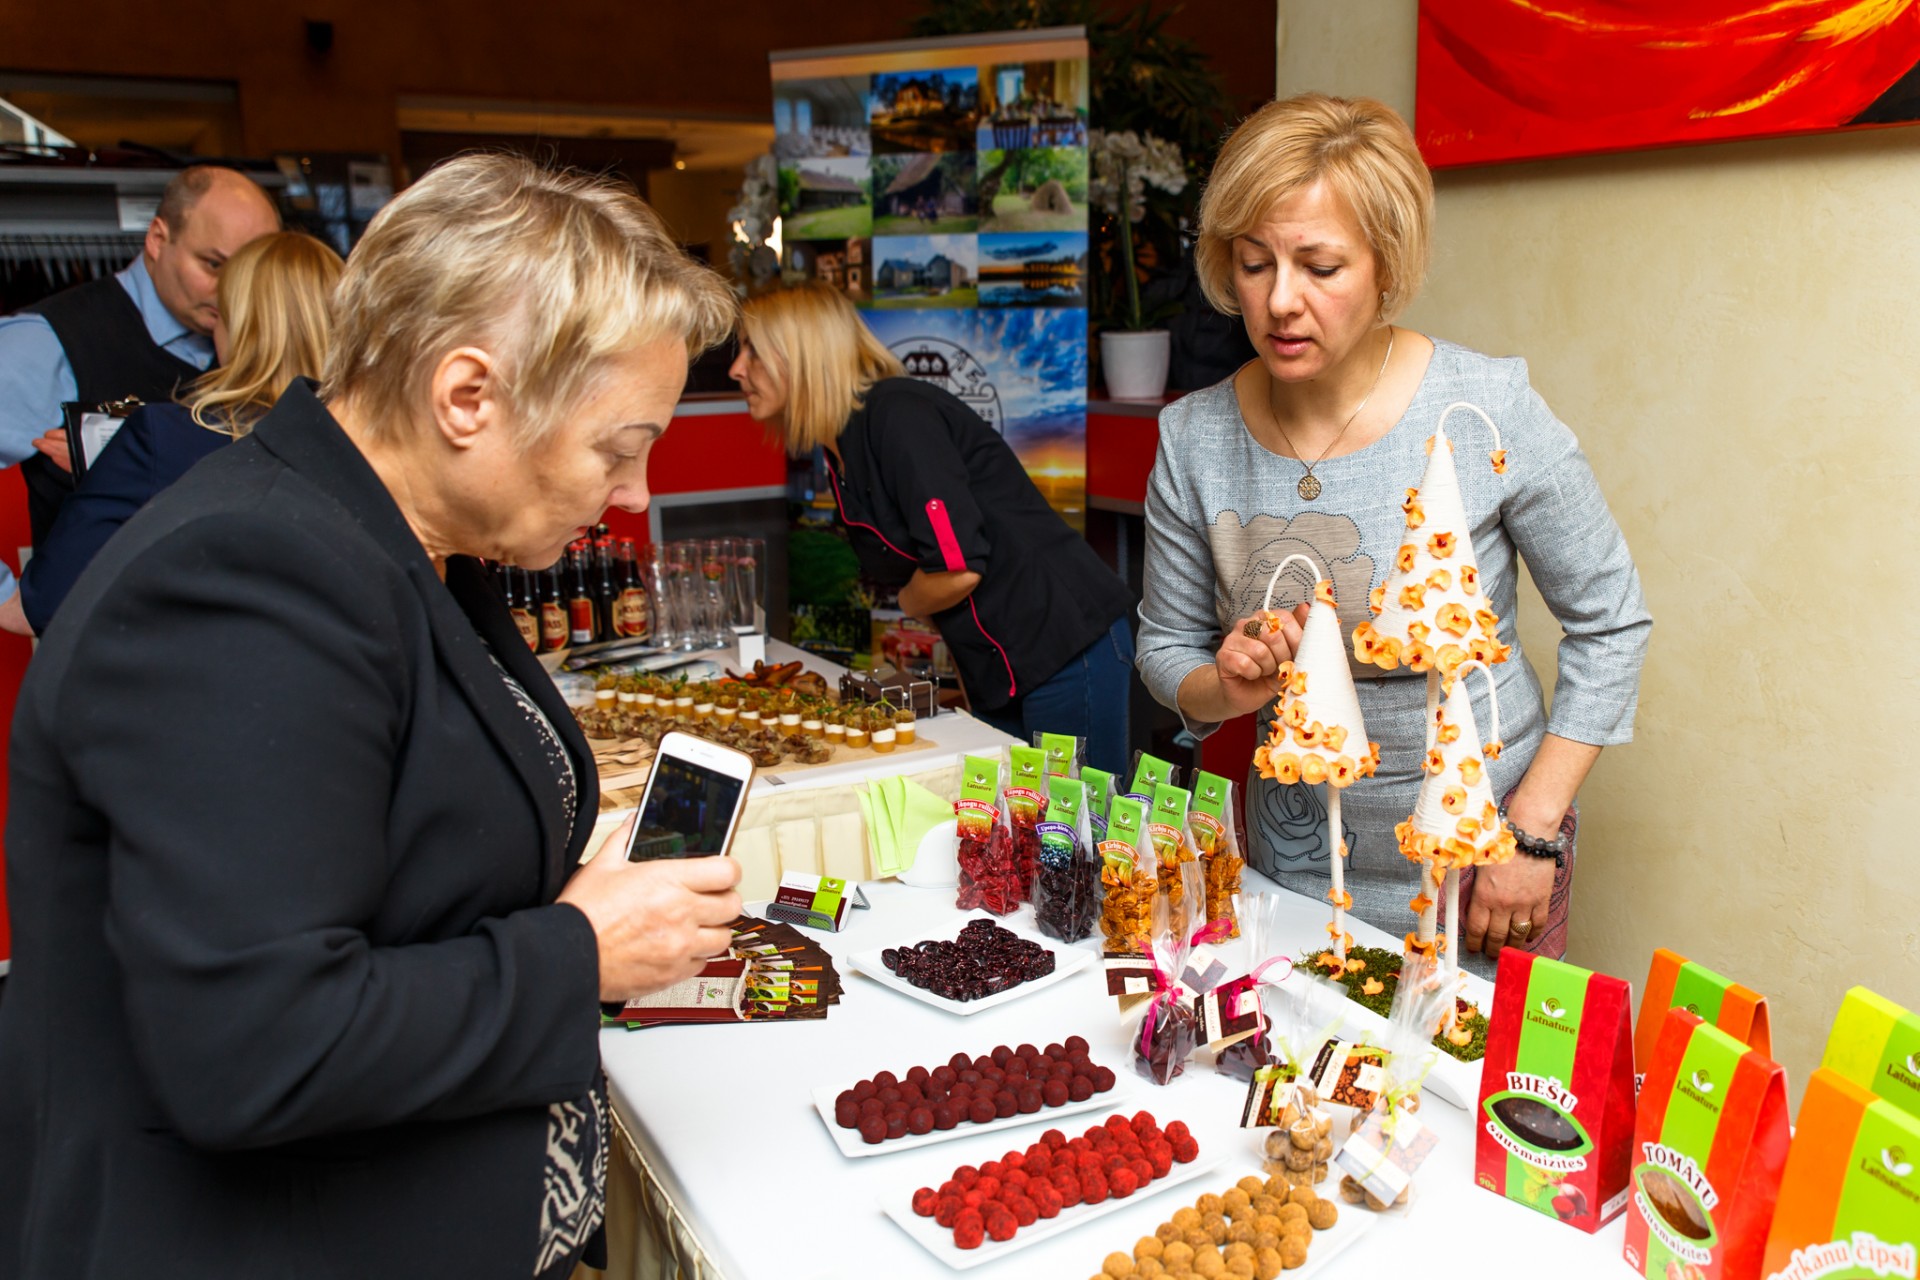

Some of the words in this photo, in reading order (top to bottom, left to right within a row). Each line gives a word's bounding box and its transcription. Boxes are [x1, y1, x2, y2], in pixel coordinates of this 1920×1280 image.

[1016, 770, 1038, 779] Latnature
[966, 782, 992, 792] Latnature
[1198, 793, 1220, 806] Latnature
[1054, 804, 1076, 816] Latnature
[1157, 805, 1180, 817] Latnature
[1113, 821, 1136, 833] Latnature
[819, 886, 841, 895] Latnature
[1526, 1011, 1576, 1036] Latnature
[1509, 1074, 1576, 1111] BIEŠU
[1676, 1079, 1720, 1115] Latnature
[1644, 1145, 1716, 1208] TOMĀTU
[1855, 1237, 1911, 1271] čipsi
